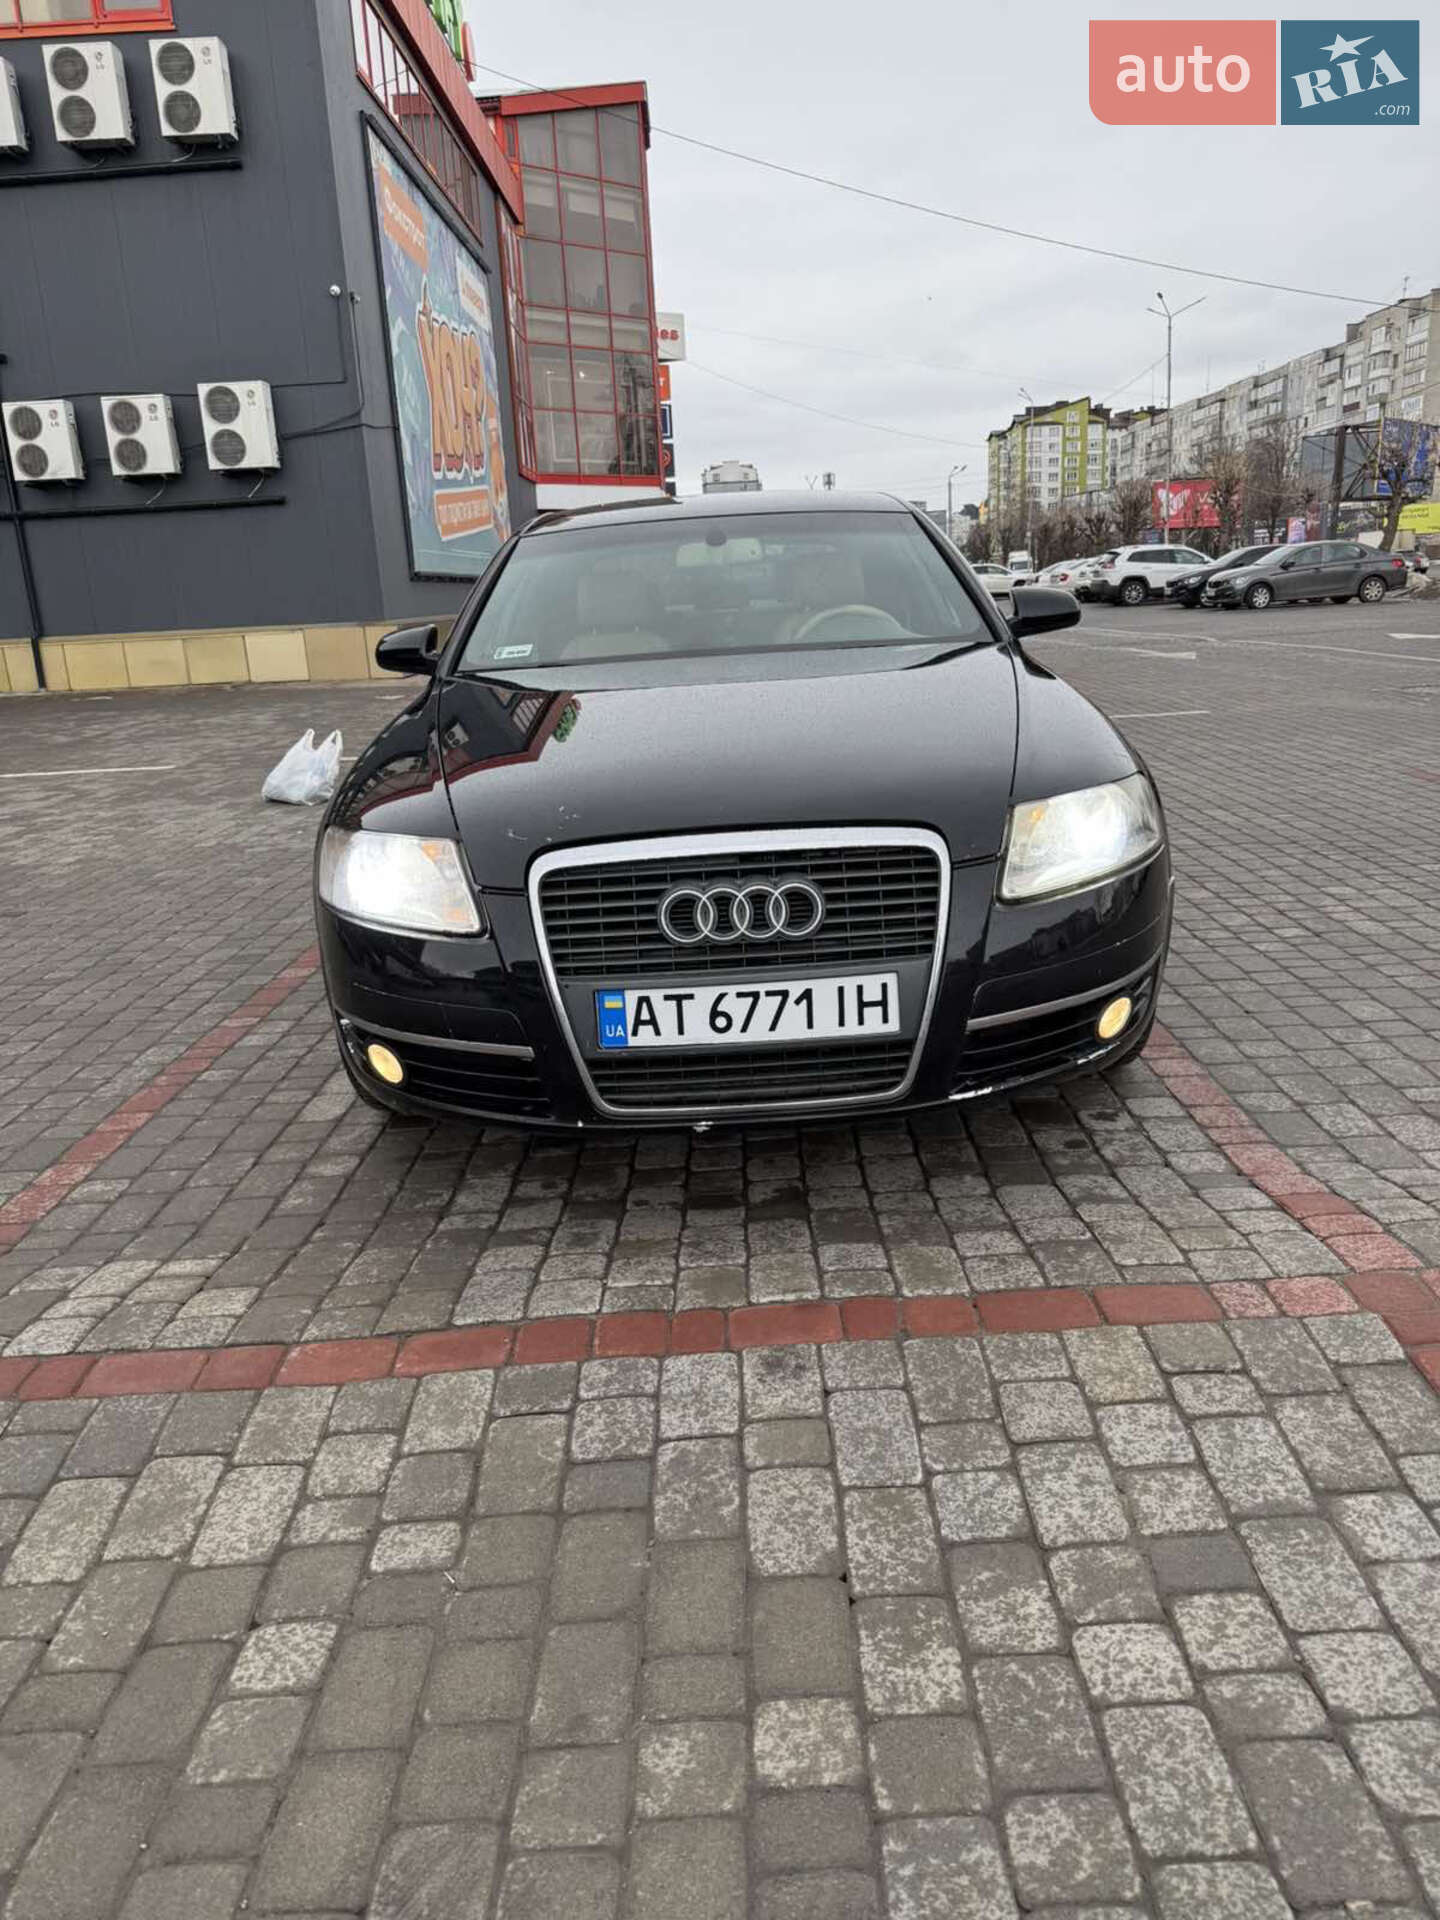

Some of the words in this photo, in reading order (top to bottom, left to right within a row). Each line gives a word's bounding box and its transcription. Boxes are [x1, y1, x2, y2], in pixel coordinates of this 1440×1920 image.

[631, 993, 695, 1037] AT
[709, 987, 814, 1034] 6771
[837, 982, 889, 1028] IH
[605, 1023, 625, 1038] UA
